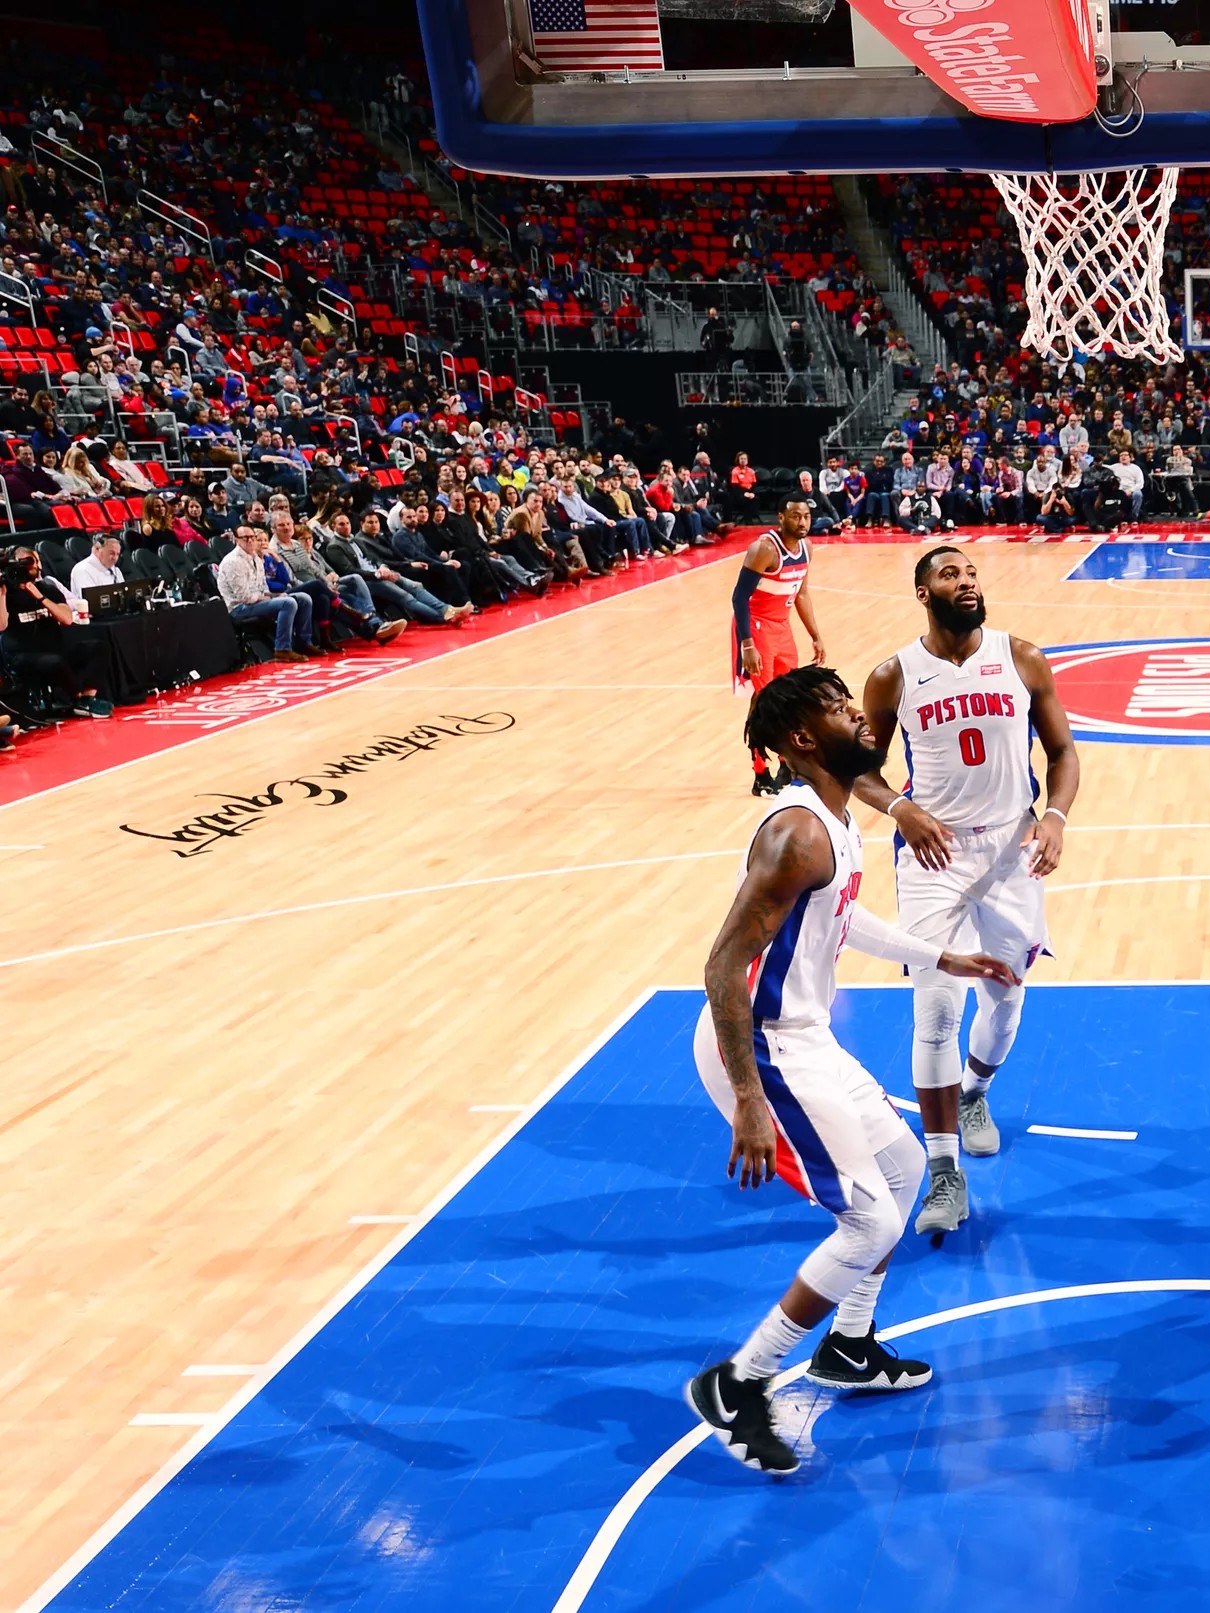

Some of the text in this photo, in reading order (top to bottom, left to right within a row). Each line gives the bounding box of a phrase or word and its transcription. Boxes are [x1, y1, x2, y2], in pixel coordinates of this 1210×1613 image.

[917, 692, 1016, 732] PISTONS
[959, 727, 987, 767] 0
[119, 711, 516, 858] Platinum Equity
